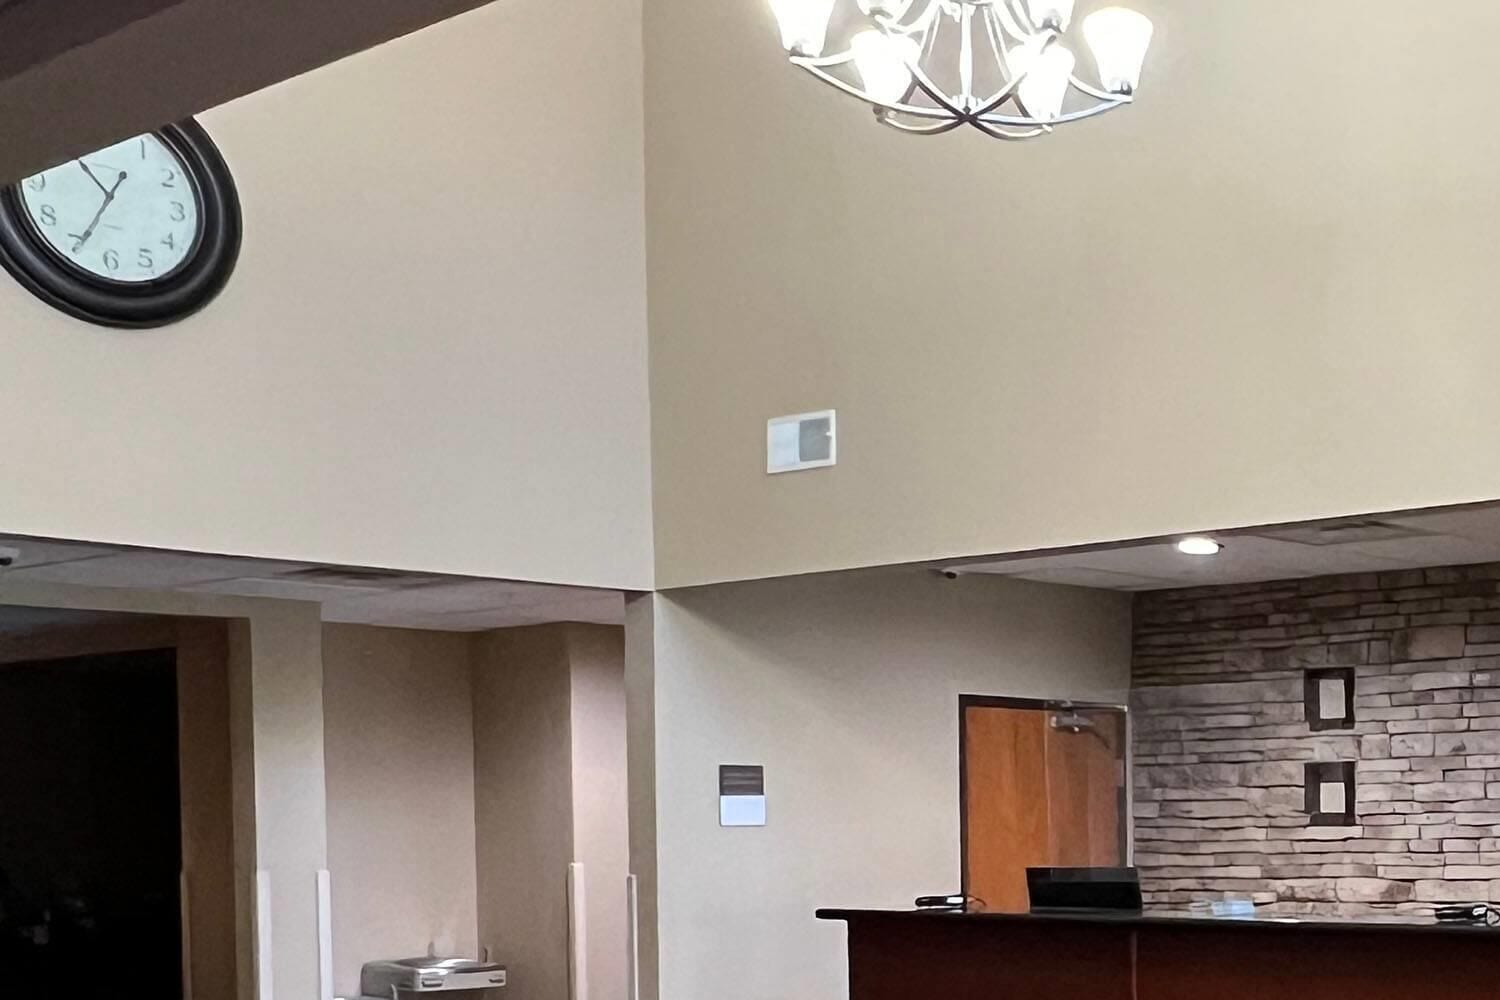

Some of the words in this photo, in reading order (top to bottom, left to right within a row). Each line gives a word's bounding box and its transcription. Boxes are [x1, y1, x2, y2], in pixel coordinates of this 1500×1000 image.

[161, 168, 175, 187] 2
[40, 205, 56, 225] 8
[170, 201, 185, 221] 3
[161, 232, 174, 250] 4
[103, 249, 119, 270] 6
[138, 248, 153, 268] 5
